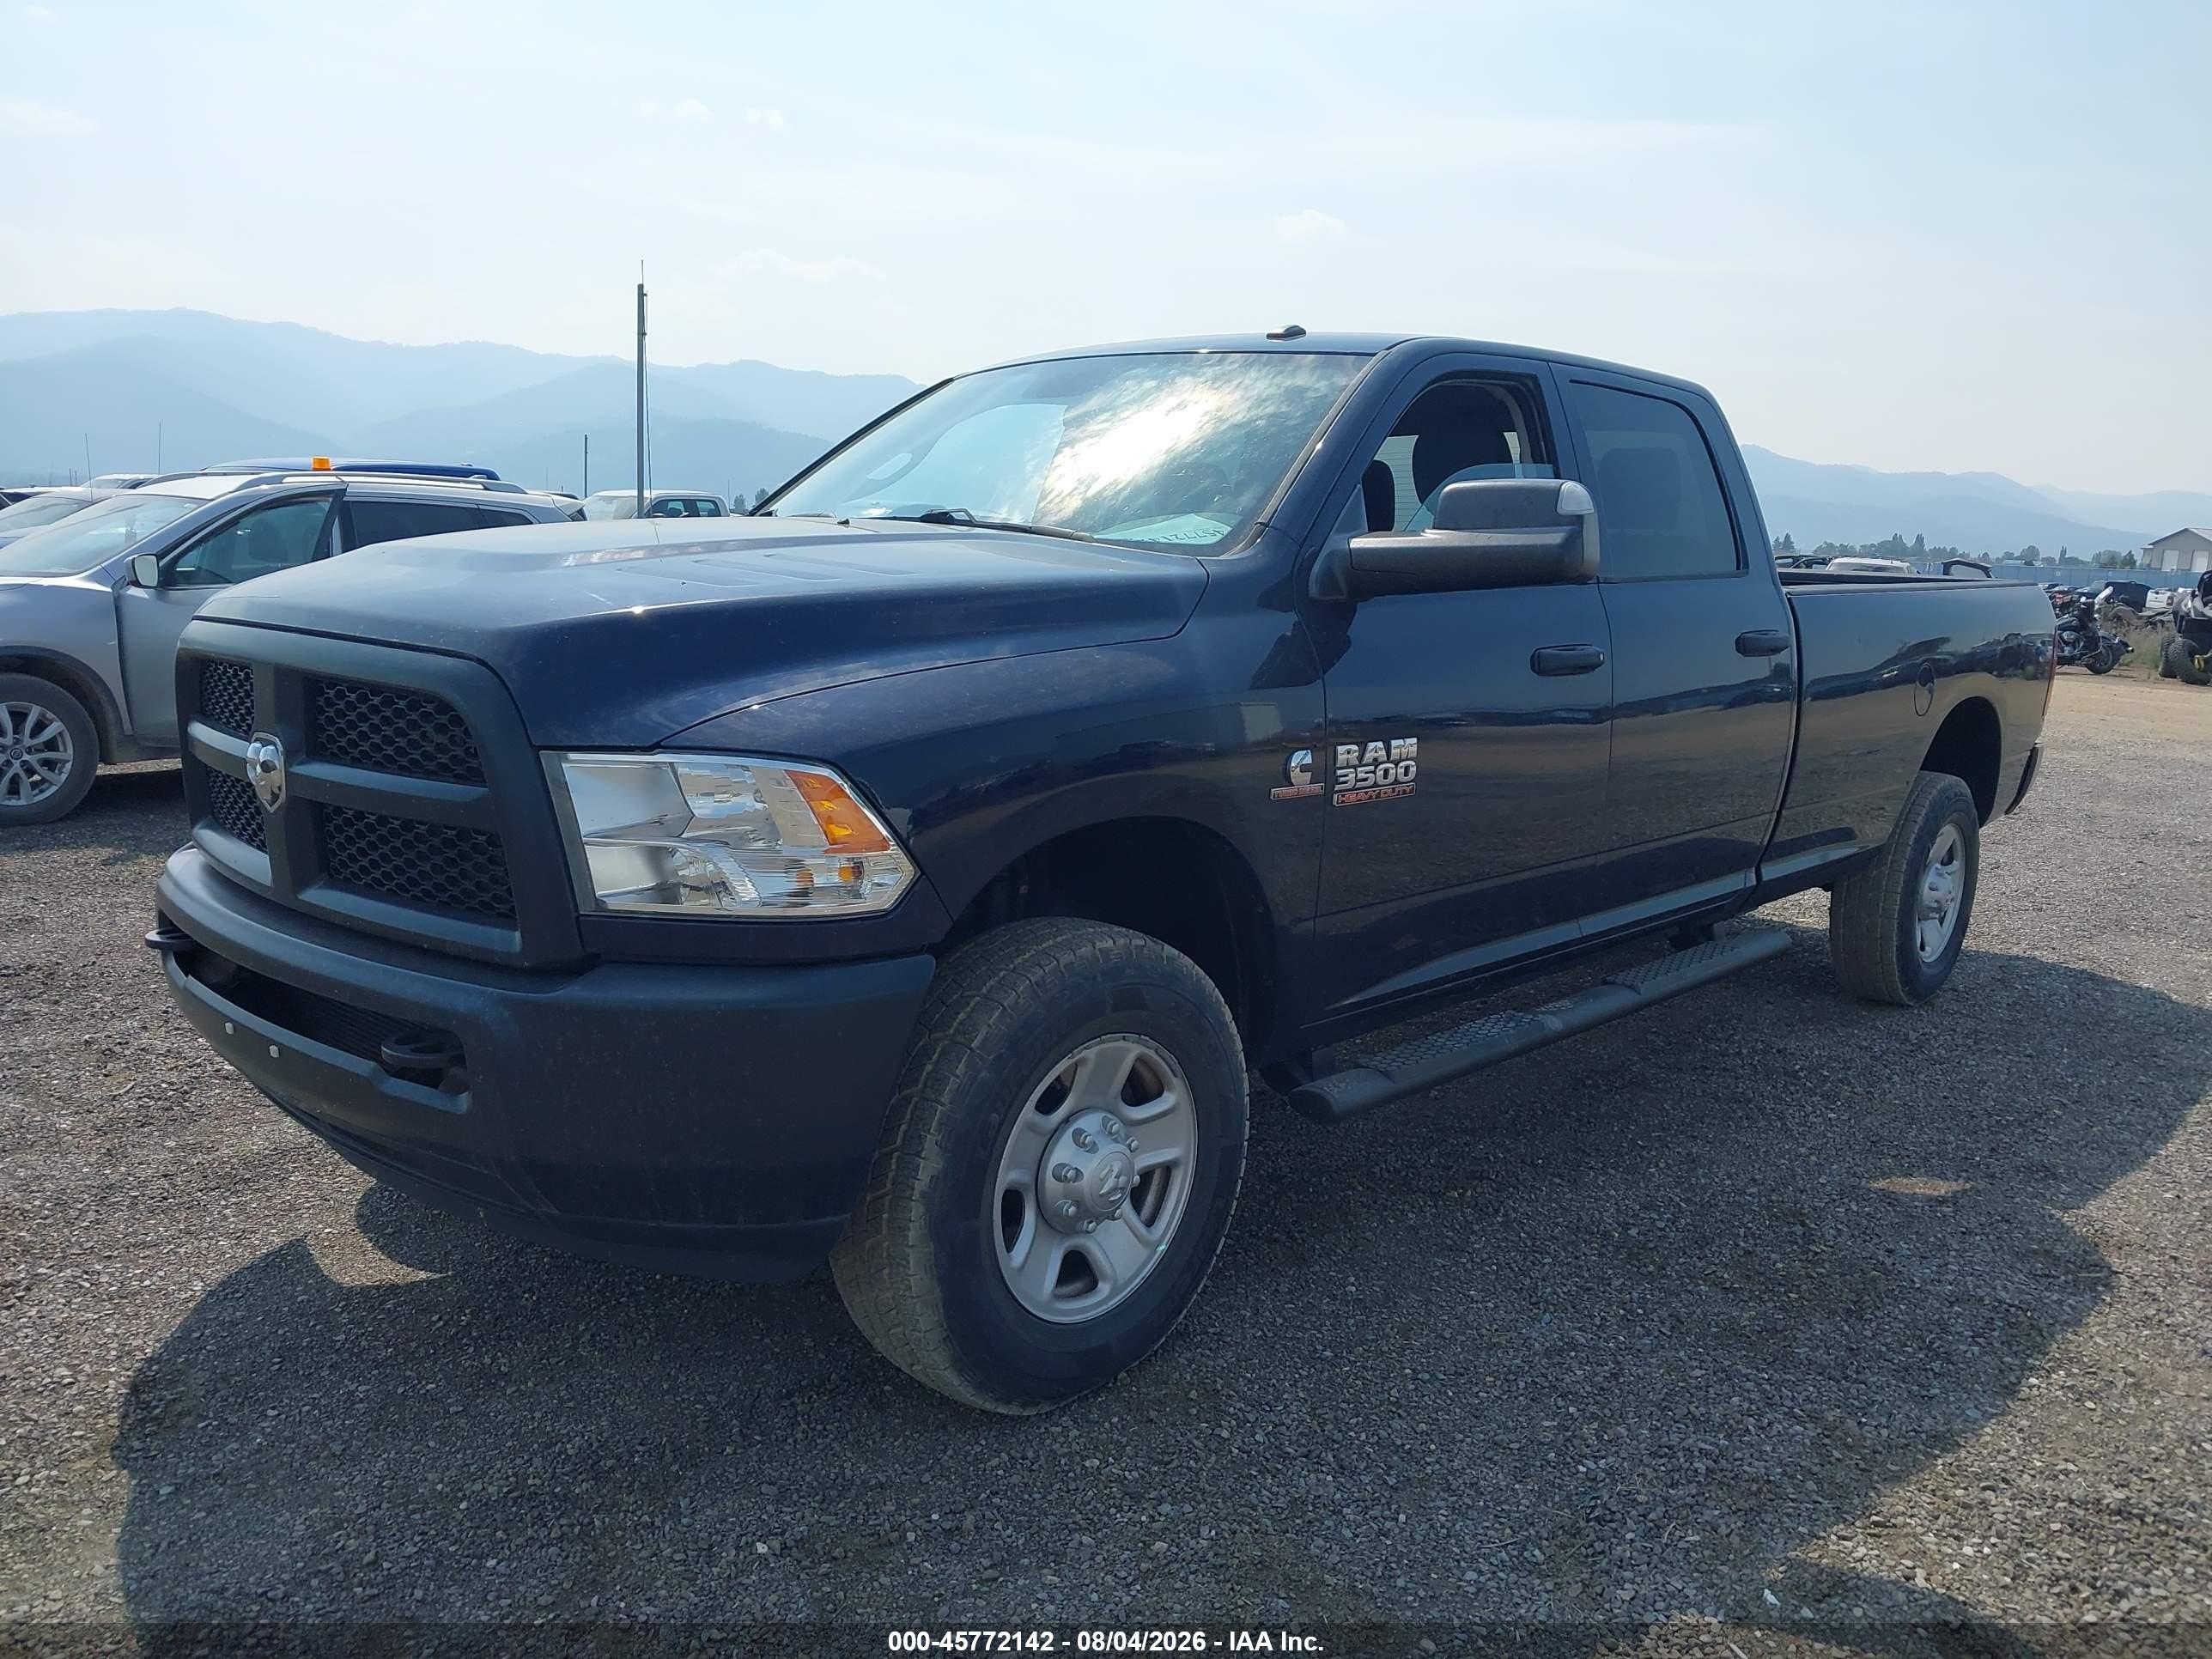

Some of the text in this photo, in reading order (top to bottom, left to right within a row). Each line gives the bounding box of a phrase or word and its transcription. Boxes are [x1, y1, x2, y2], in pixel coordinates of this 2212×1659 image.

[1335, 737, 1418, 768] RAM
[1334, 760, 1417, 791] 3500
[1338, 790, 1380, 804] HEAVY
[1379, 785, 1414, 799] DUTY
